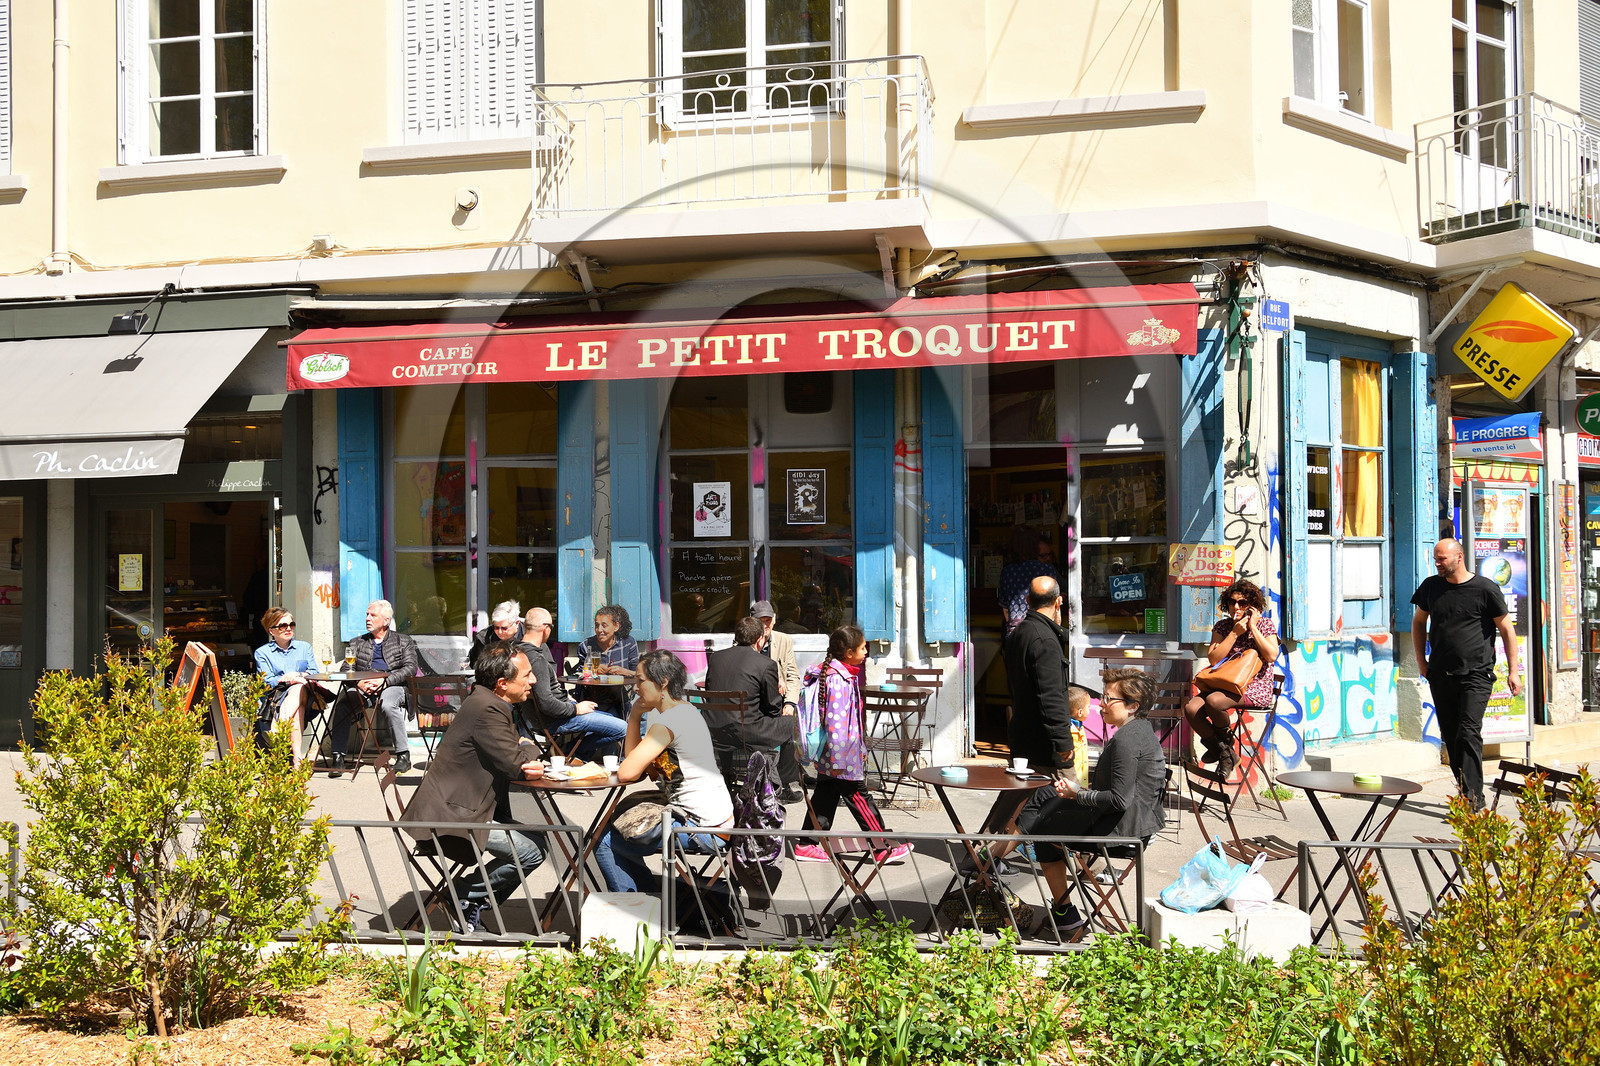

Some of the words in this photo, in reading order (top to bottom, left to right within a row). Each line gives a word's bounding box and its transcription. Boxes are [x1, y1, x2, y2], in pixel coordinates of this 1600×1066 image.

[1270, 303, 1281, 313] RUE
[1262, 314, 1289, 328] BELFORT
[419, 343, 473, 360] CAFÉ
[545, 341, 607, 371] LE
[637, 333, 787, 368] PETIT
[818, 320, 1076, 359] TROQUET
[306, 356, 343, 375] Grolsch
[392, 362, 498, 379] COMPTOIR
[1460, 337, 1521, 391] PRESSE
[1456, 431, 1470, 442] LE
[32, 451, 72, 473] Ph.
[78, 446, 160, 472] Caclin
[205, 477, 242, 491] Philippe
[1474, 540, 1500, 549] SCIENCES
[1197, 546, 1223, 559] Hot
[1195, 559, 1233, 574] Dogs
[1113, 578, 1131, 588] Come
[1114, 589, 1143, 600] OPEN
